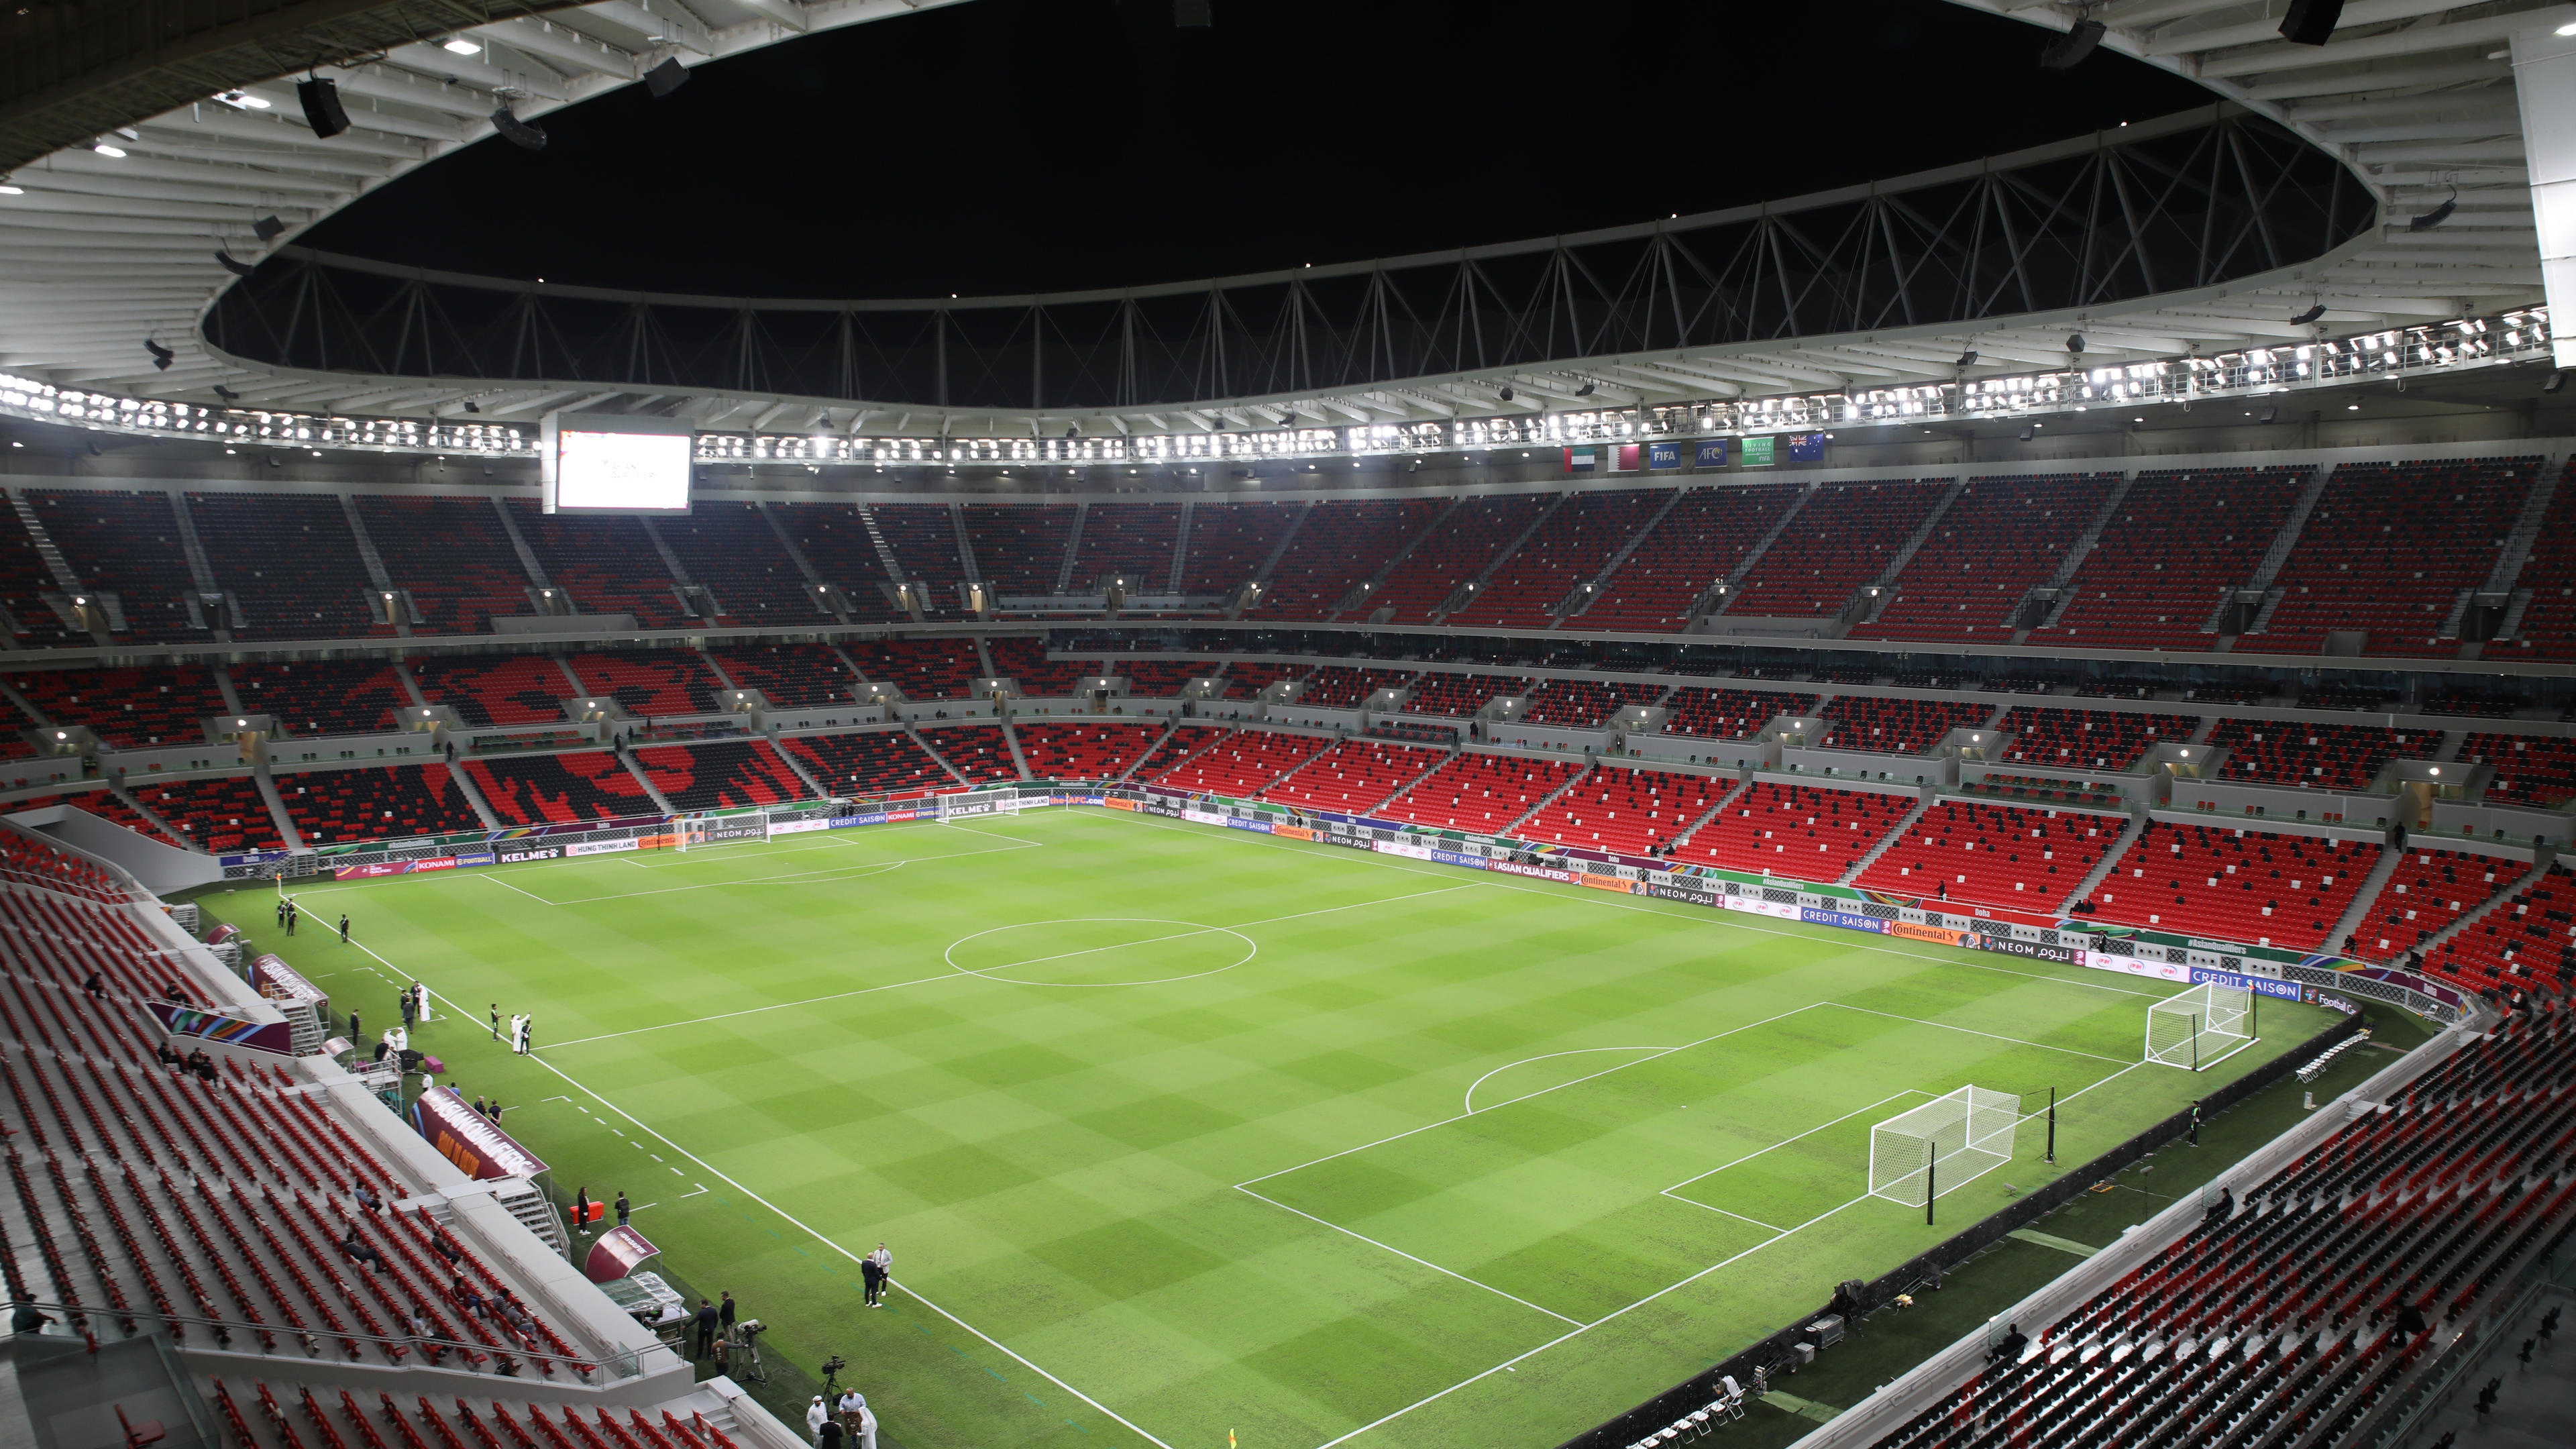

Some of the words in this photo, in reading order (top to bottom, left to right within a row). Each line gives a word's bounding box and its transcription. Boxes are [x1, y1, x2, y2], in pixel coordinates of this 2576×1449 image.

[1654, 450, 1676, 462] FIFA
[1699, 447, 1723, 461] AFC
[888, 812, 914, 820] KONAMI
[949, 805, 983, 816] KELME
[1149, 806, 1165, 814] NEOM
[830, 818, 857, 826] CREDIT
[859, 814, 885, 824] SAISON
[1228, 818, 1248, 828] CREDIT
[1248, 822, 1270, 832] SAISON
[717, 830, 742, 839] NEOM
[1277, 824, 1305, 837] Continental
[597, 843, 619, 851] THINH
[1332, 836, 1352, 845] NEOM
[502, 850, 549, 863] KELME
[1432, 851, 1457, 863] CREDIT
[1459, 855, 1486, 867] SAISON
[1608, 855, 1620, 863] Doha
[419, 860, 455, 869] KONAMI
[1497, 862, 1522, 874] ASIAN
[1522, 866, 1570, 881] QUALIFIERS
[1580, 873, 1621, 889] Continental
[1762, 877, 1805, 891] #AsianQualifiers
[1660, 888, 1687, 900] NEOM
[1688, 894, 1713, 904] نيوم
[1975, 908, 1990, 918] Doha
[1803, 910, 1839, 923] CREDIT
[1841, 916, 1879, 930] SAISON
[1892, 923, 1945, 940] Continental
[1998, 941, 2034, 955] NEOM
[2188, 938, 2247, 955] #AsianQualifiers
[2037, 948, 2070, 961] نيوم
[2192, 971, 2242, 987] CREDIT
[2246, 979, 2296, 997] SAISON
[2318, 993, 2347, 1012] Football
